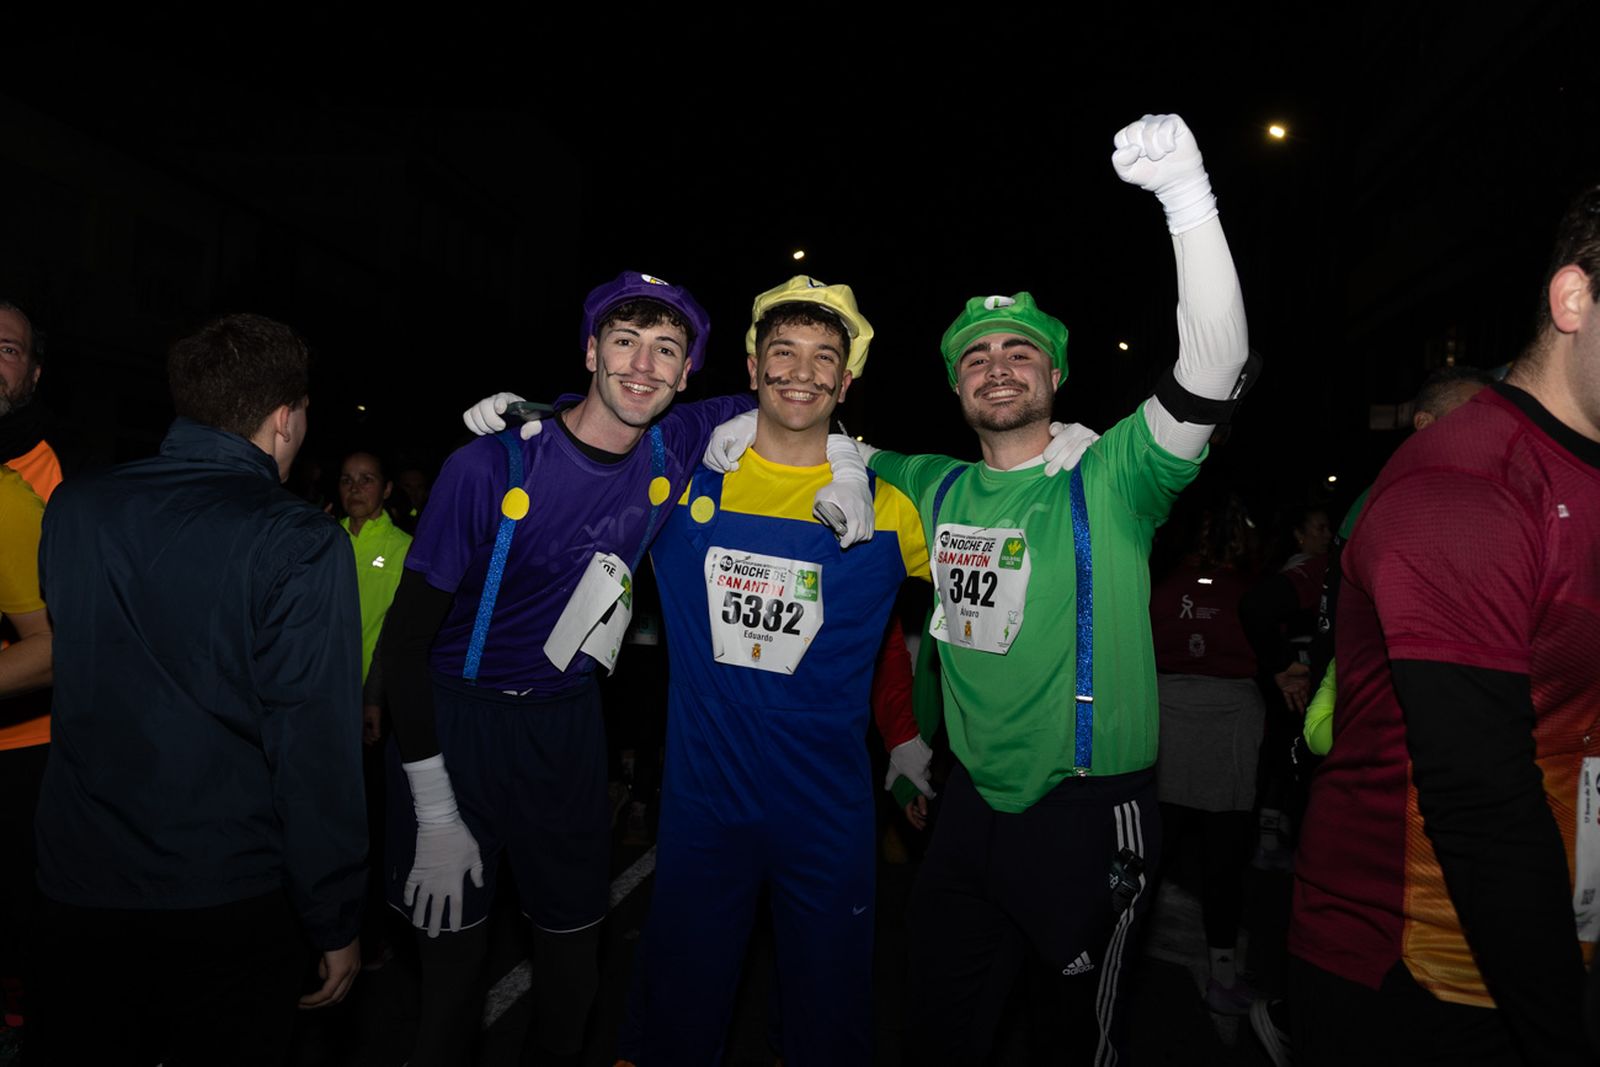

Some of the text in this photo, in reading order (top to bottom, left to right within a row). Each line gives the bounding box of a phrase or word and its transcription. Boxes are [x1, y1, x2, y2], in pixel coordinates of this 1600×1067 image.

[949, 540, 995, 553] NOCHE DE
[937, 550, 957, 566] SAN
[956, 551, 991, 568] ANTÓN
[733, 564, 771, 579] NOCHE
[718, 574, 741, 589] SAN
[949, 568, 998, 608] 342
[721, 591, 805, 636] 5382
[959, 607, 979, 619] Álvaro
[743, 630, 774, 642] Eduardo
